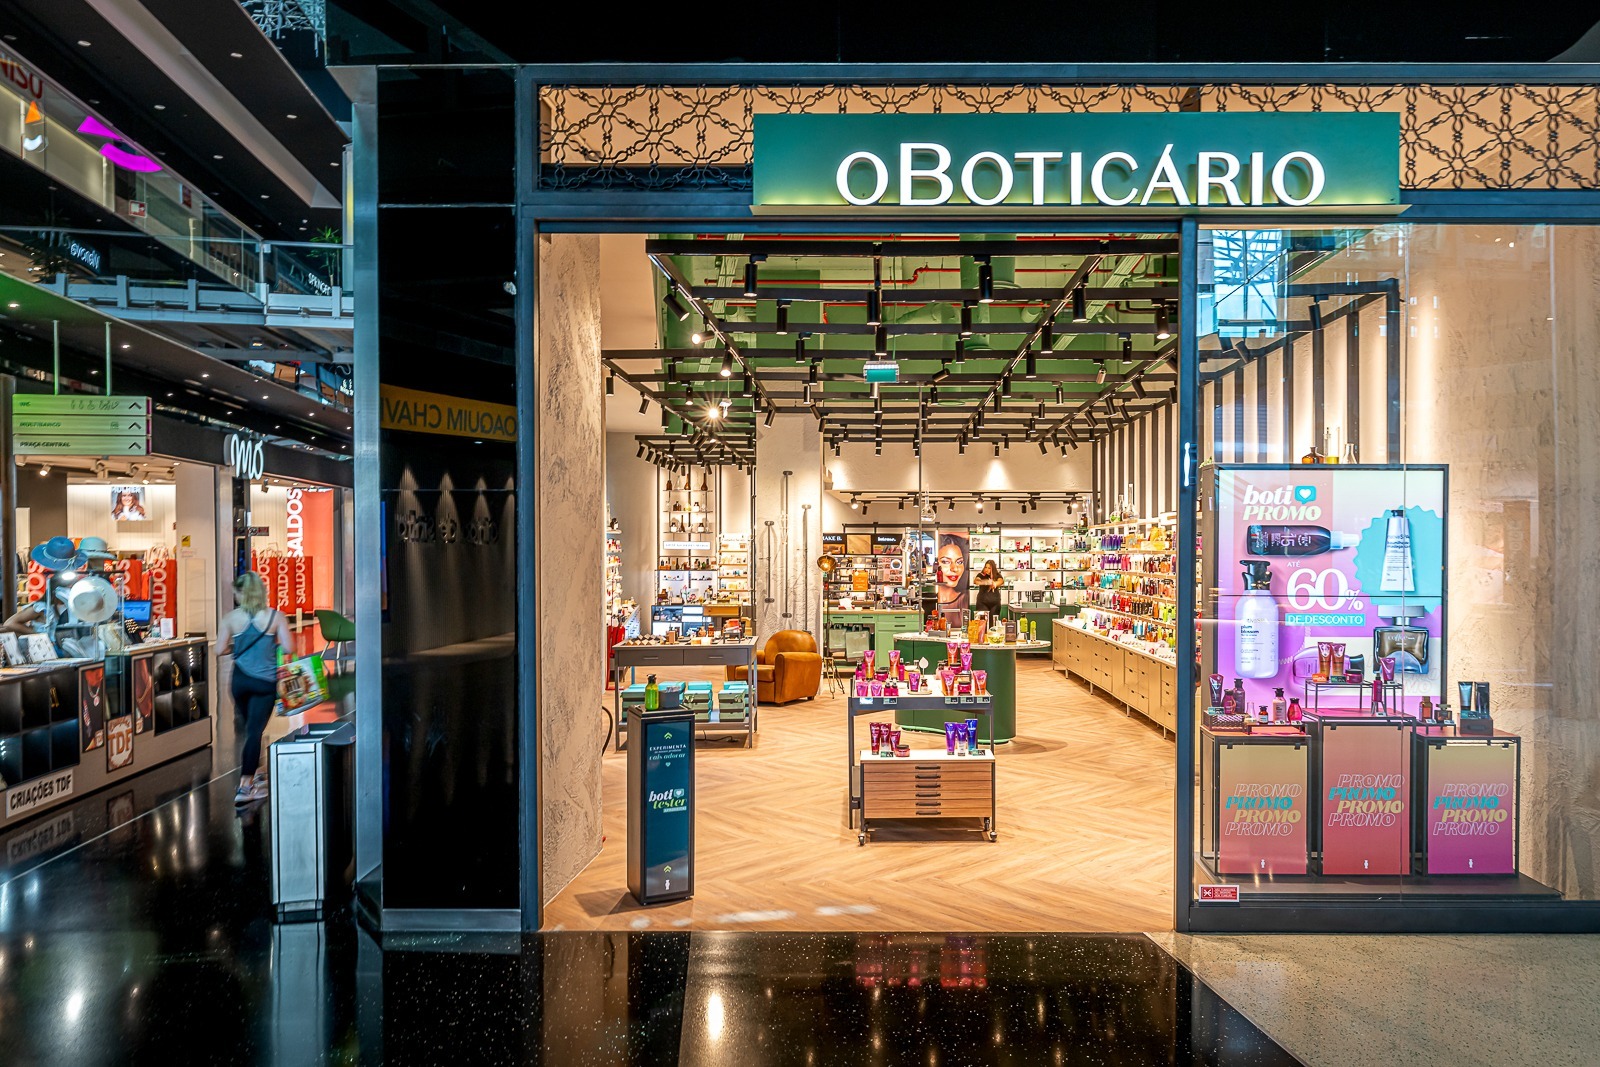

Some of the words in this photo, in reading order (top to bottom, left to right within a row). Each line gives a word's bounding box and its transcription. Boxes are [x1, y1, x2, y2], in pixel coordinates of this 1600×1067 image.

[1243, 484, 1294, 505] boti
[1243, 505, 1322, 521] PROMO
[1287, 560, 1301, 568] ATÉ
[1286, 567, 1364, 611] 60%
[1287, 614, 1303, 625] DE
[1304, 614, 1364, 625] DESCONTO
[1337, 774, 1405, 788] PROMO
[10, 781, 54, 810] CRIAÇÕES
[55, 774, 72, 796] TDF
[1233, 783, 1303, 798] PROMO
[1441, 782, 1509, 797] PROMO
[1337, 799, 1405, 815] PROMO
[1233, 809, 1302, 824] PROMO
[1327, 812, 1396, 827] PROMO
[1441, 808, 1508, 823] PROMO
[1224, 821, 1293, 837] PROMO
[1432, 821, 1500, 836] PROMO
